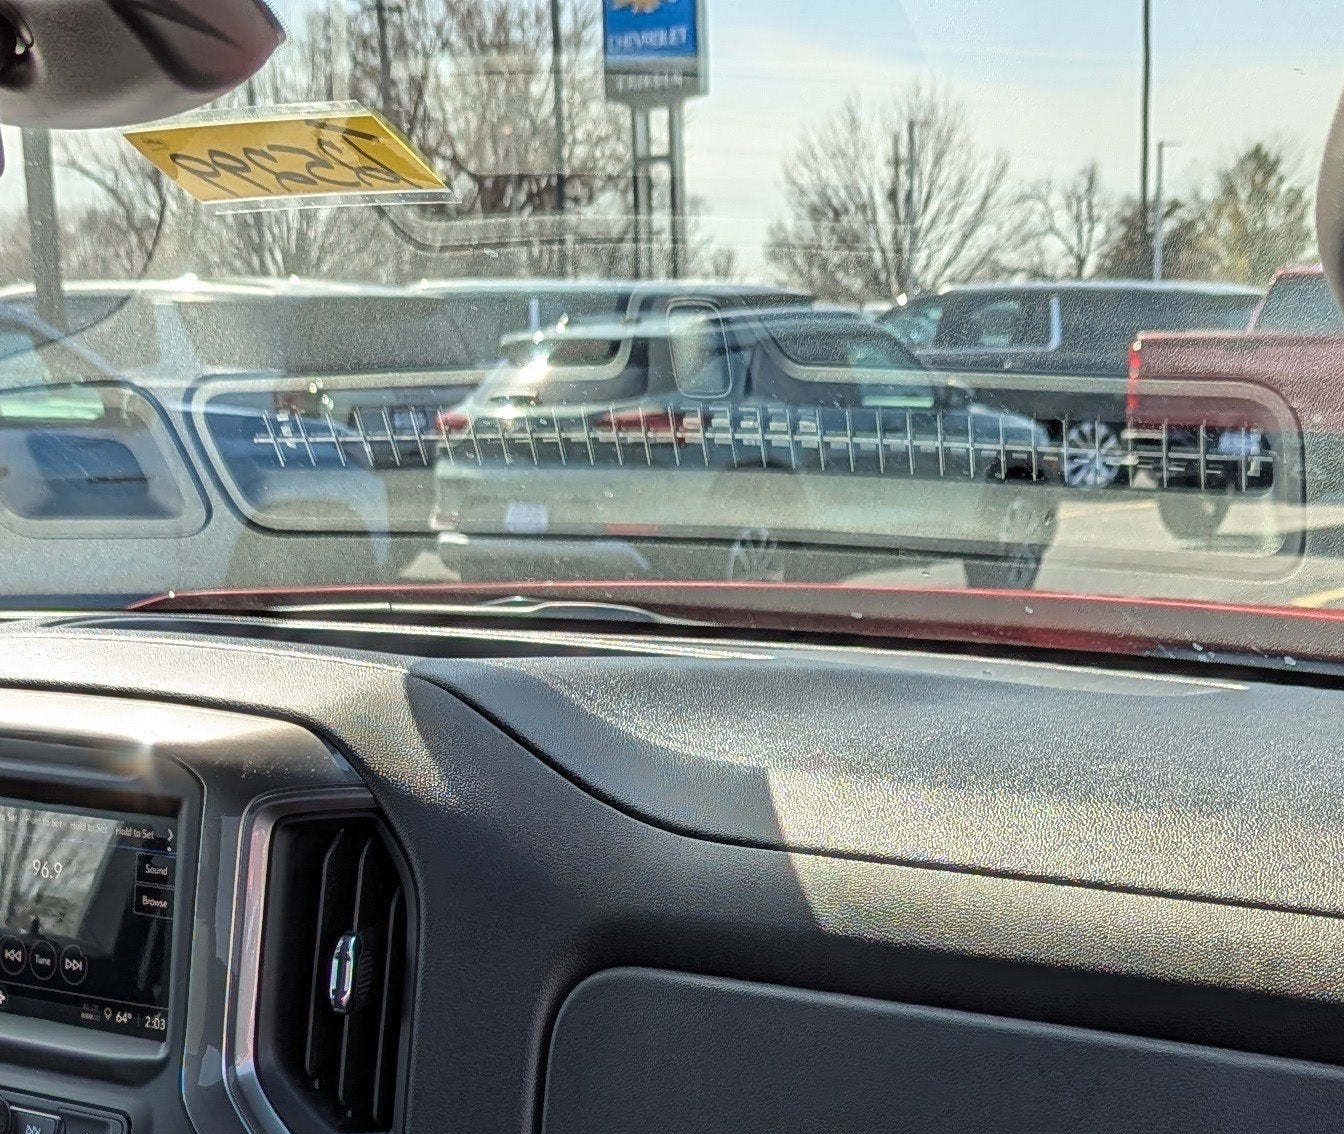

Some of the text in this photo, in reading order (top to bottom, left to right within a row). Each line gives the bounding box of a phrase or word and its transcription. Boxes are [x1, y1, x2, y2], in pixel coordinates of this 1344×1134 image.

[115, 827, 155, 840] Hold to Set
[32, 859, 63, 880] 96.9
[145, 863, 168, 877] Sound
[142, 896, 168, 910] Browse
[35, 954, 51, 967] Tune
[145, 1014, 166, 1031] 2:03
